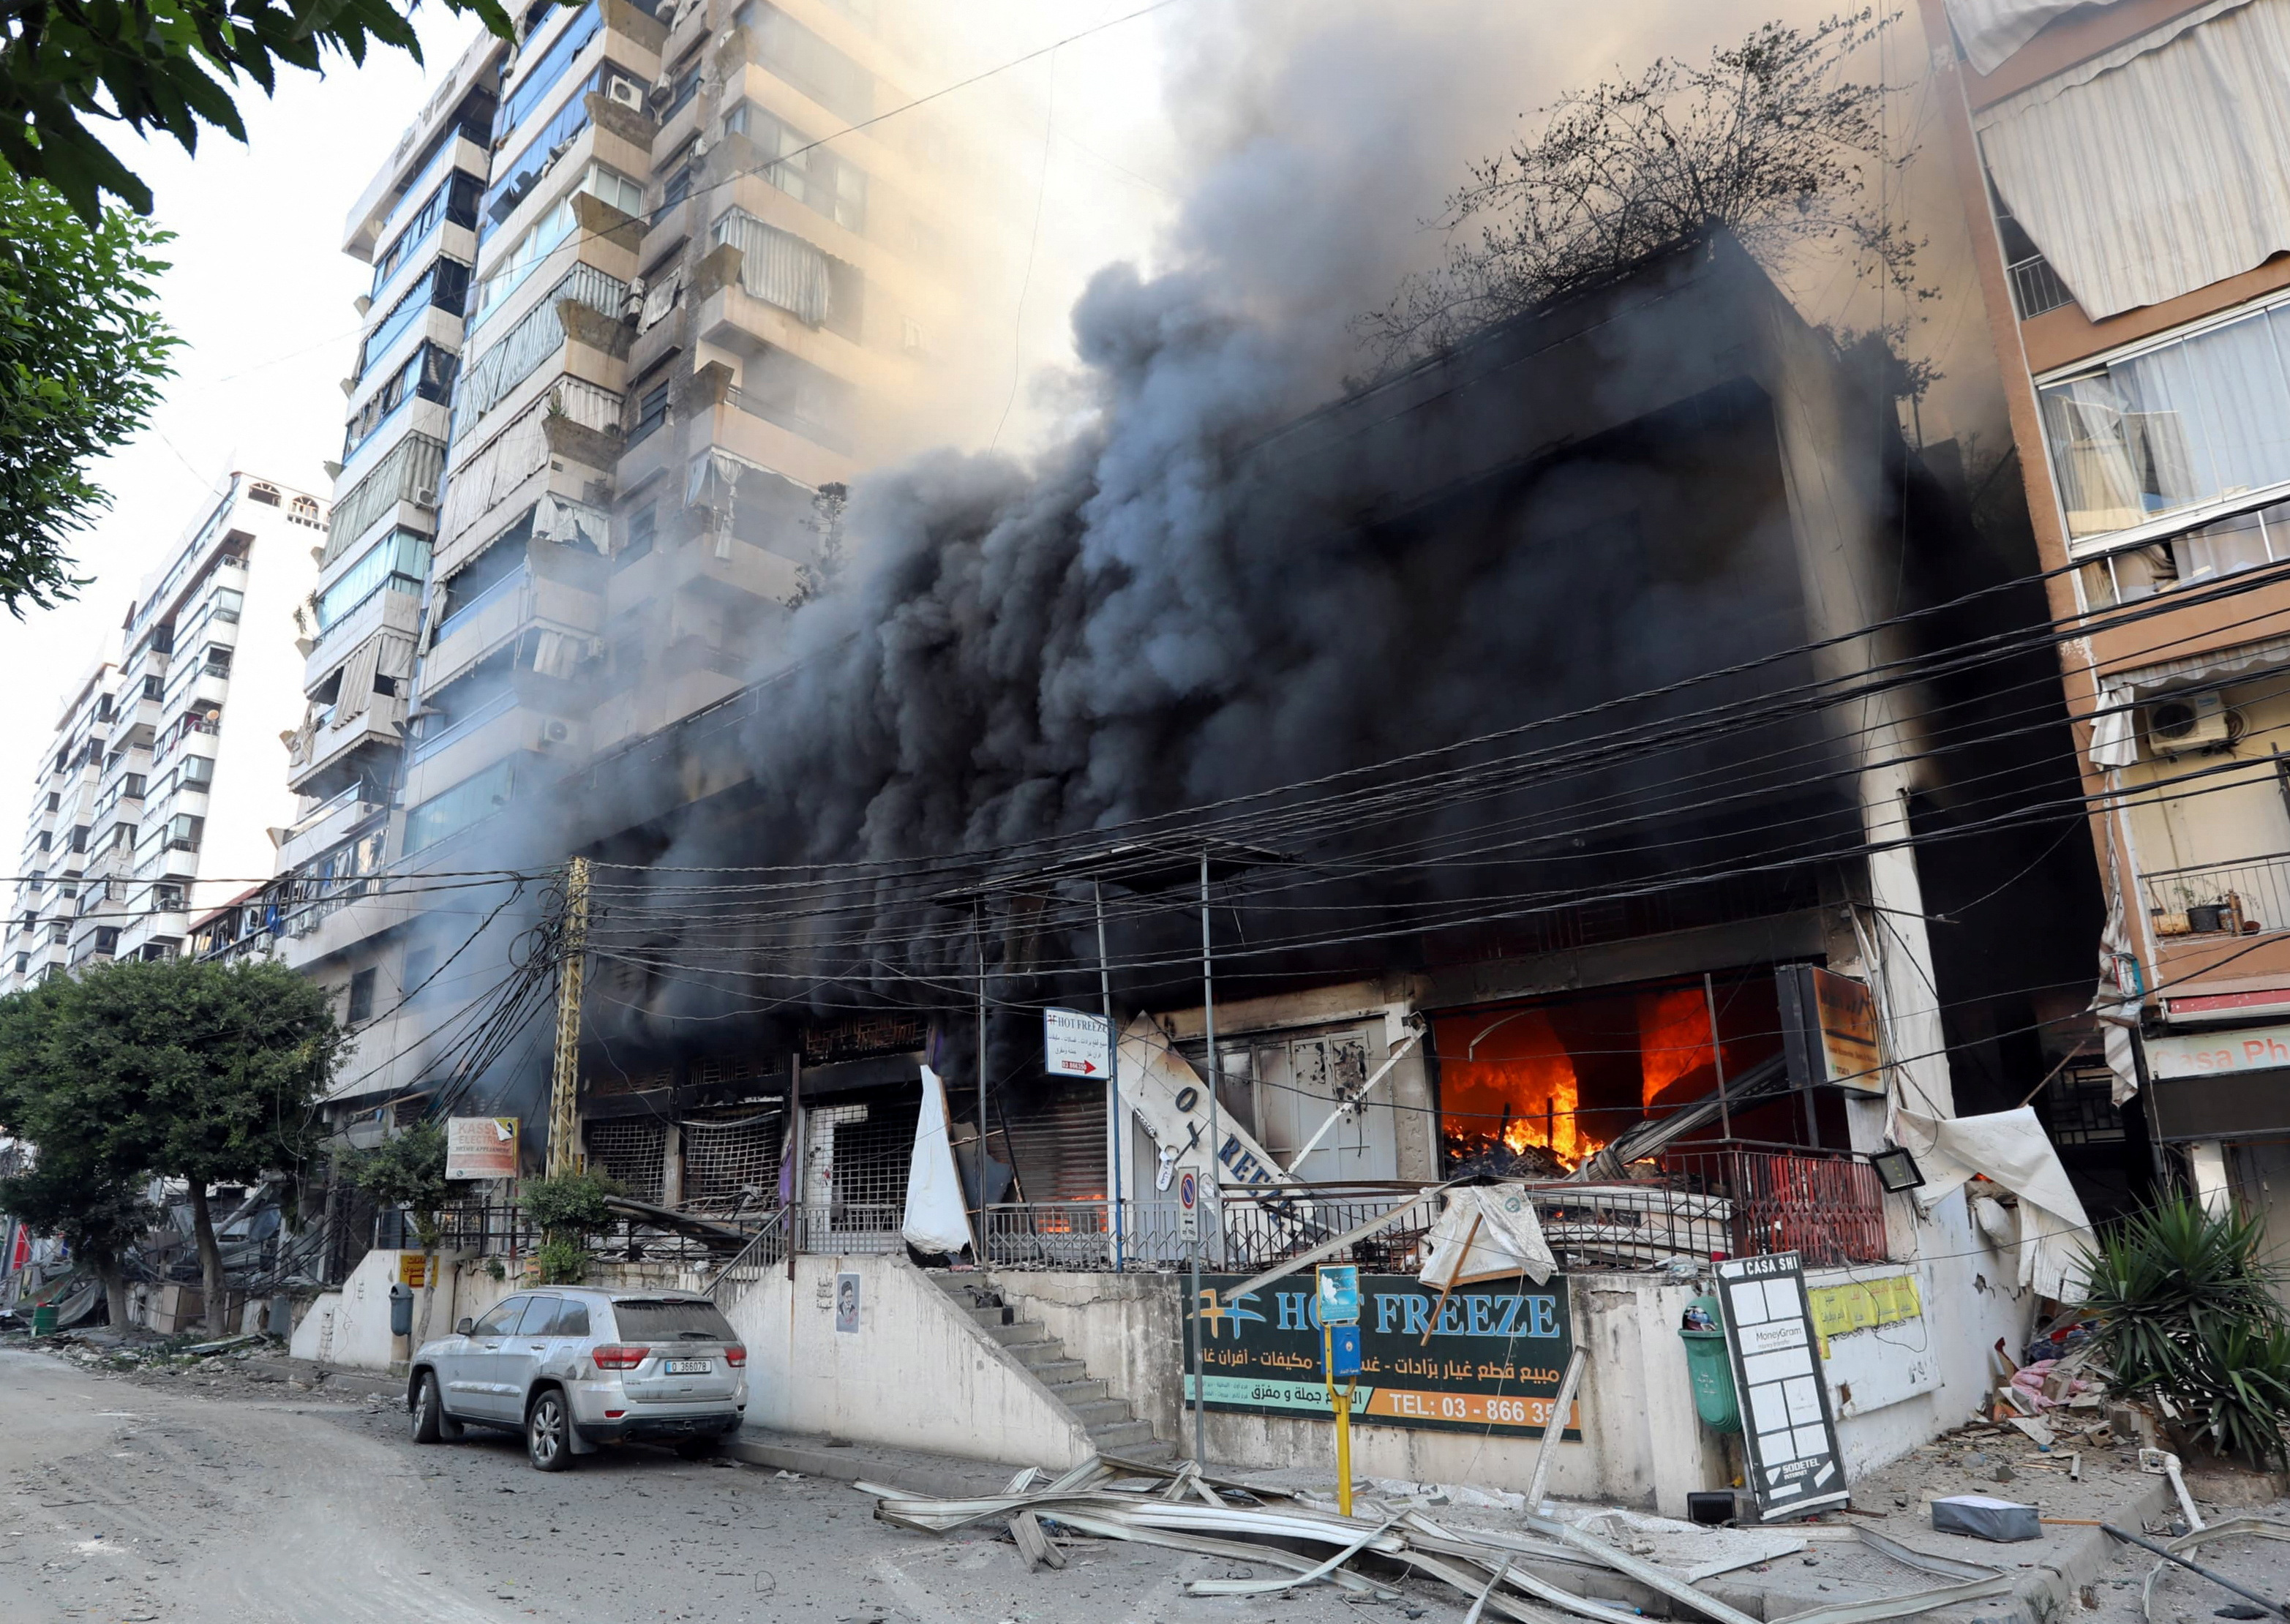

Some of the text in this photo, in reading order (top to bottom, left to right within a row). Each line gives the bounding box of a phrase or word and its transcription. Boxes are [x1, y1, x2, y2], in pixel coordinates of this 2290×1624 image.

[1058, 1016, 1108, 1034] HOT FREEZE
[2242, 1038, 2290, 1067] Ph
[458, 1122, 498, 1135] KASS
[1746, 1256, 1798, 1275] CASA SHI
[1373, 1293, 1560, 1339] FREEZE
[1756, 1327, 1802, 1341] MoneyGram
[1200, 1348, 1215, 1364] غا
[1218, 1348, 1248, 1367] أفران
[1261, 1351, 1313, 1370] مكيفات
[681, 1361, 707, 1371] 366078
[1443, 1359, 1473, 1380] غيار
[1477, 1361, 1515, 1381] قطع
[1520, 1366, 1560, 1384] مبيع
[1295, 1386, 1321, 1404] جملة
[1389, 1393, 1435, 1416] TEL:
[1442, 1397, 1466, 1418] 03
[1486, 1399, 1525, 1422] 866
[1782, 1457, 1820, 1474] SODETEL
[1783, 1469, 1807, 1480] INTERNET
